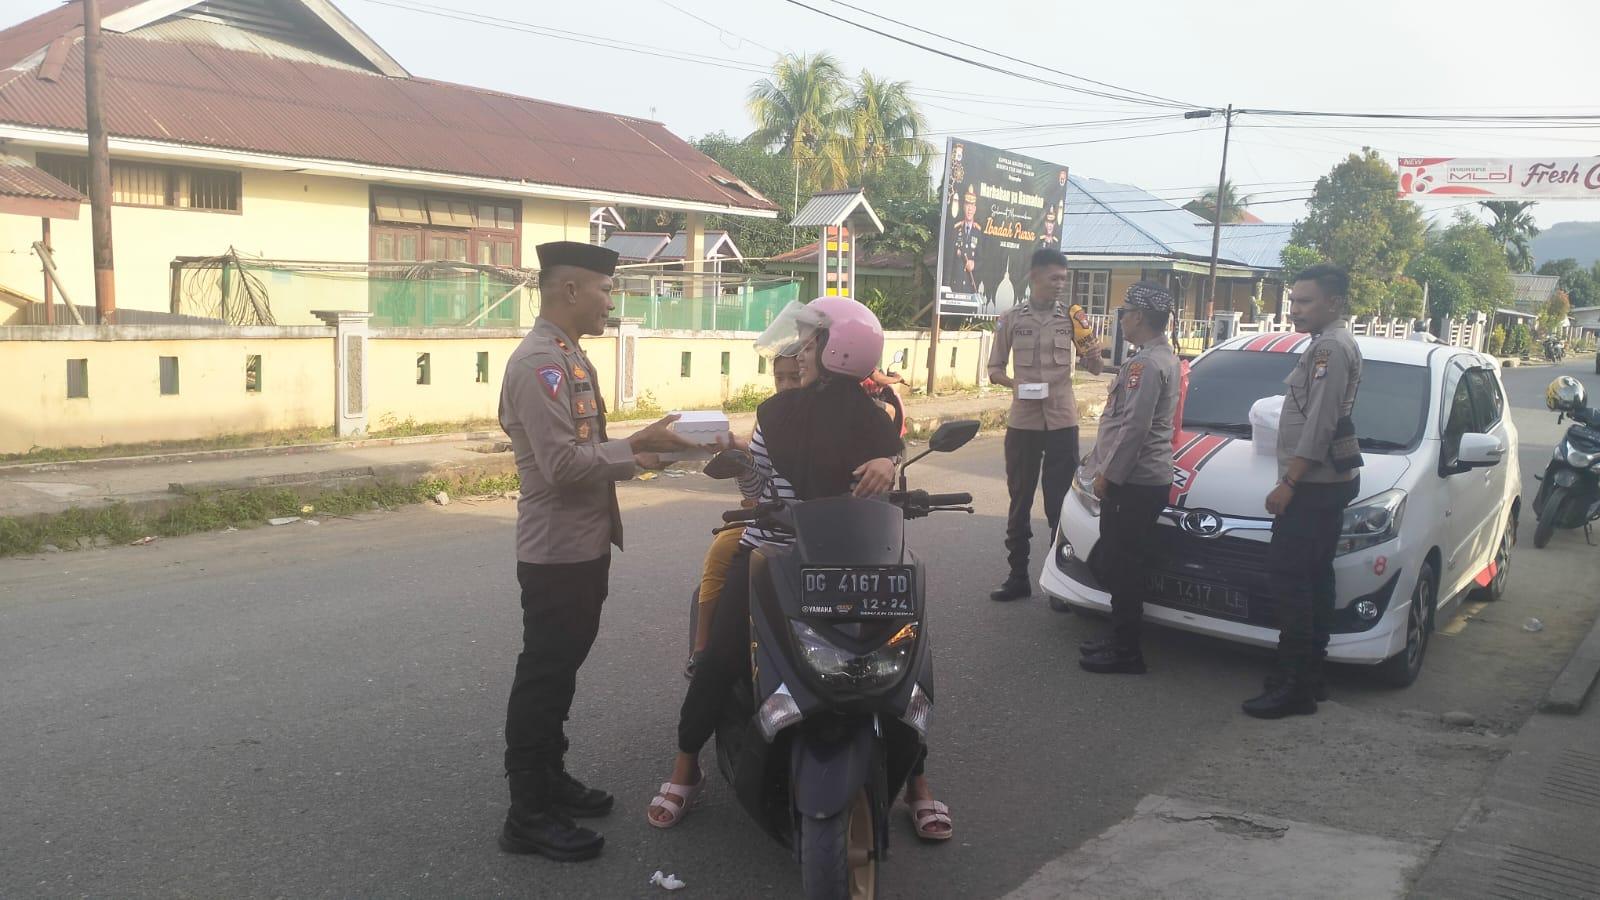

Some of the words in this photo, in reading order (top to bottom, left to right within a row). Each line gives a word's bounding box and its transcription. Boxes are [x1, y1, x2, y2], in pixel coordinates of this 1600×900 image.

[1521, 162, 1578, 187] Fresh
[983, 217, 1013, 238] Ibadah
[1013, 222, 1036, 241] Puasa
[806, 573, 826, 592] DG
[838, 574, 880, 593] 4167
[888, 575, 907, 593] TD
